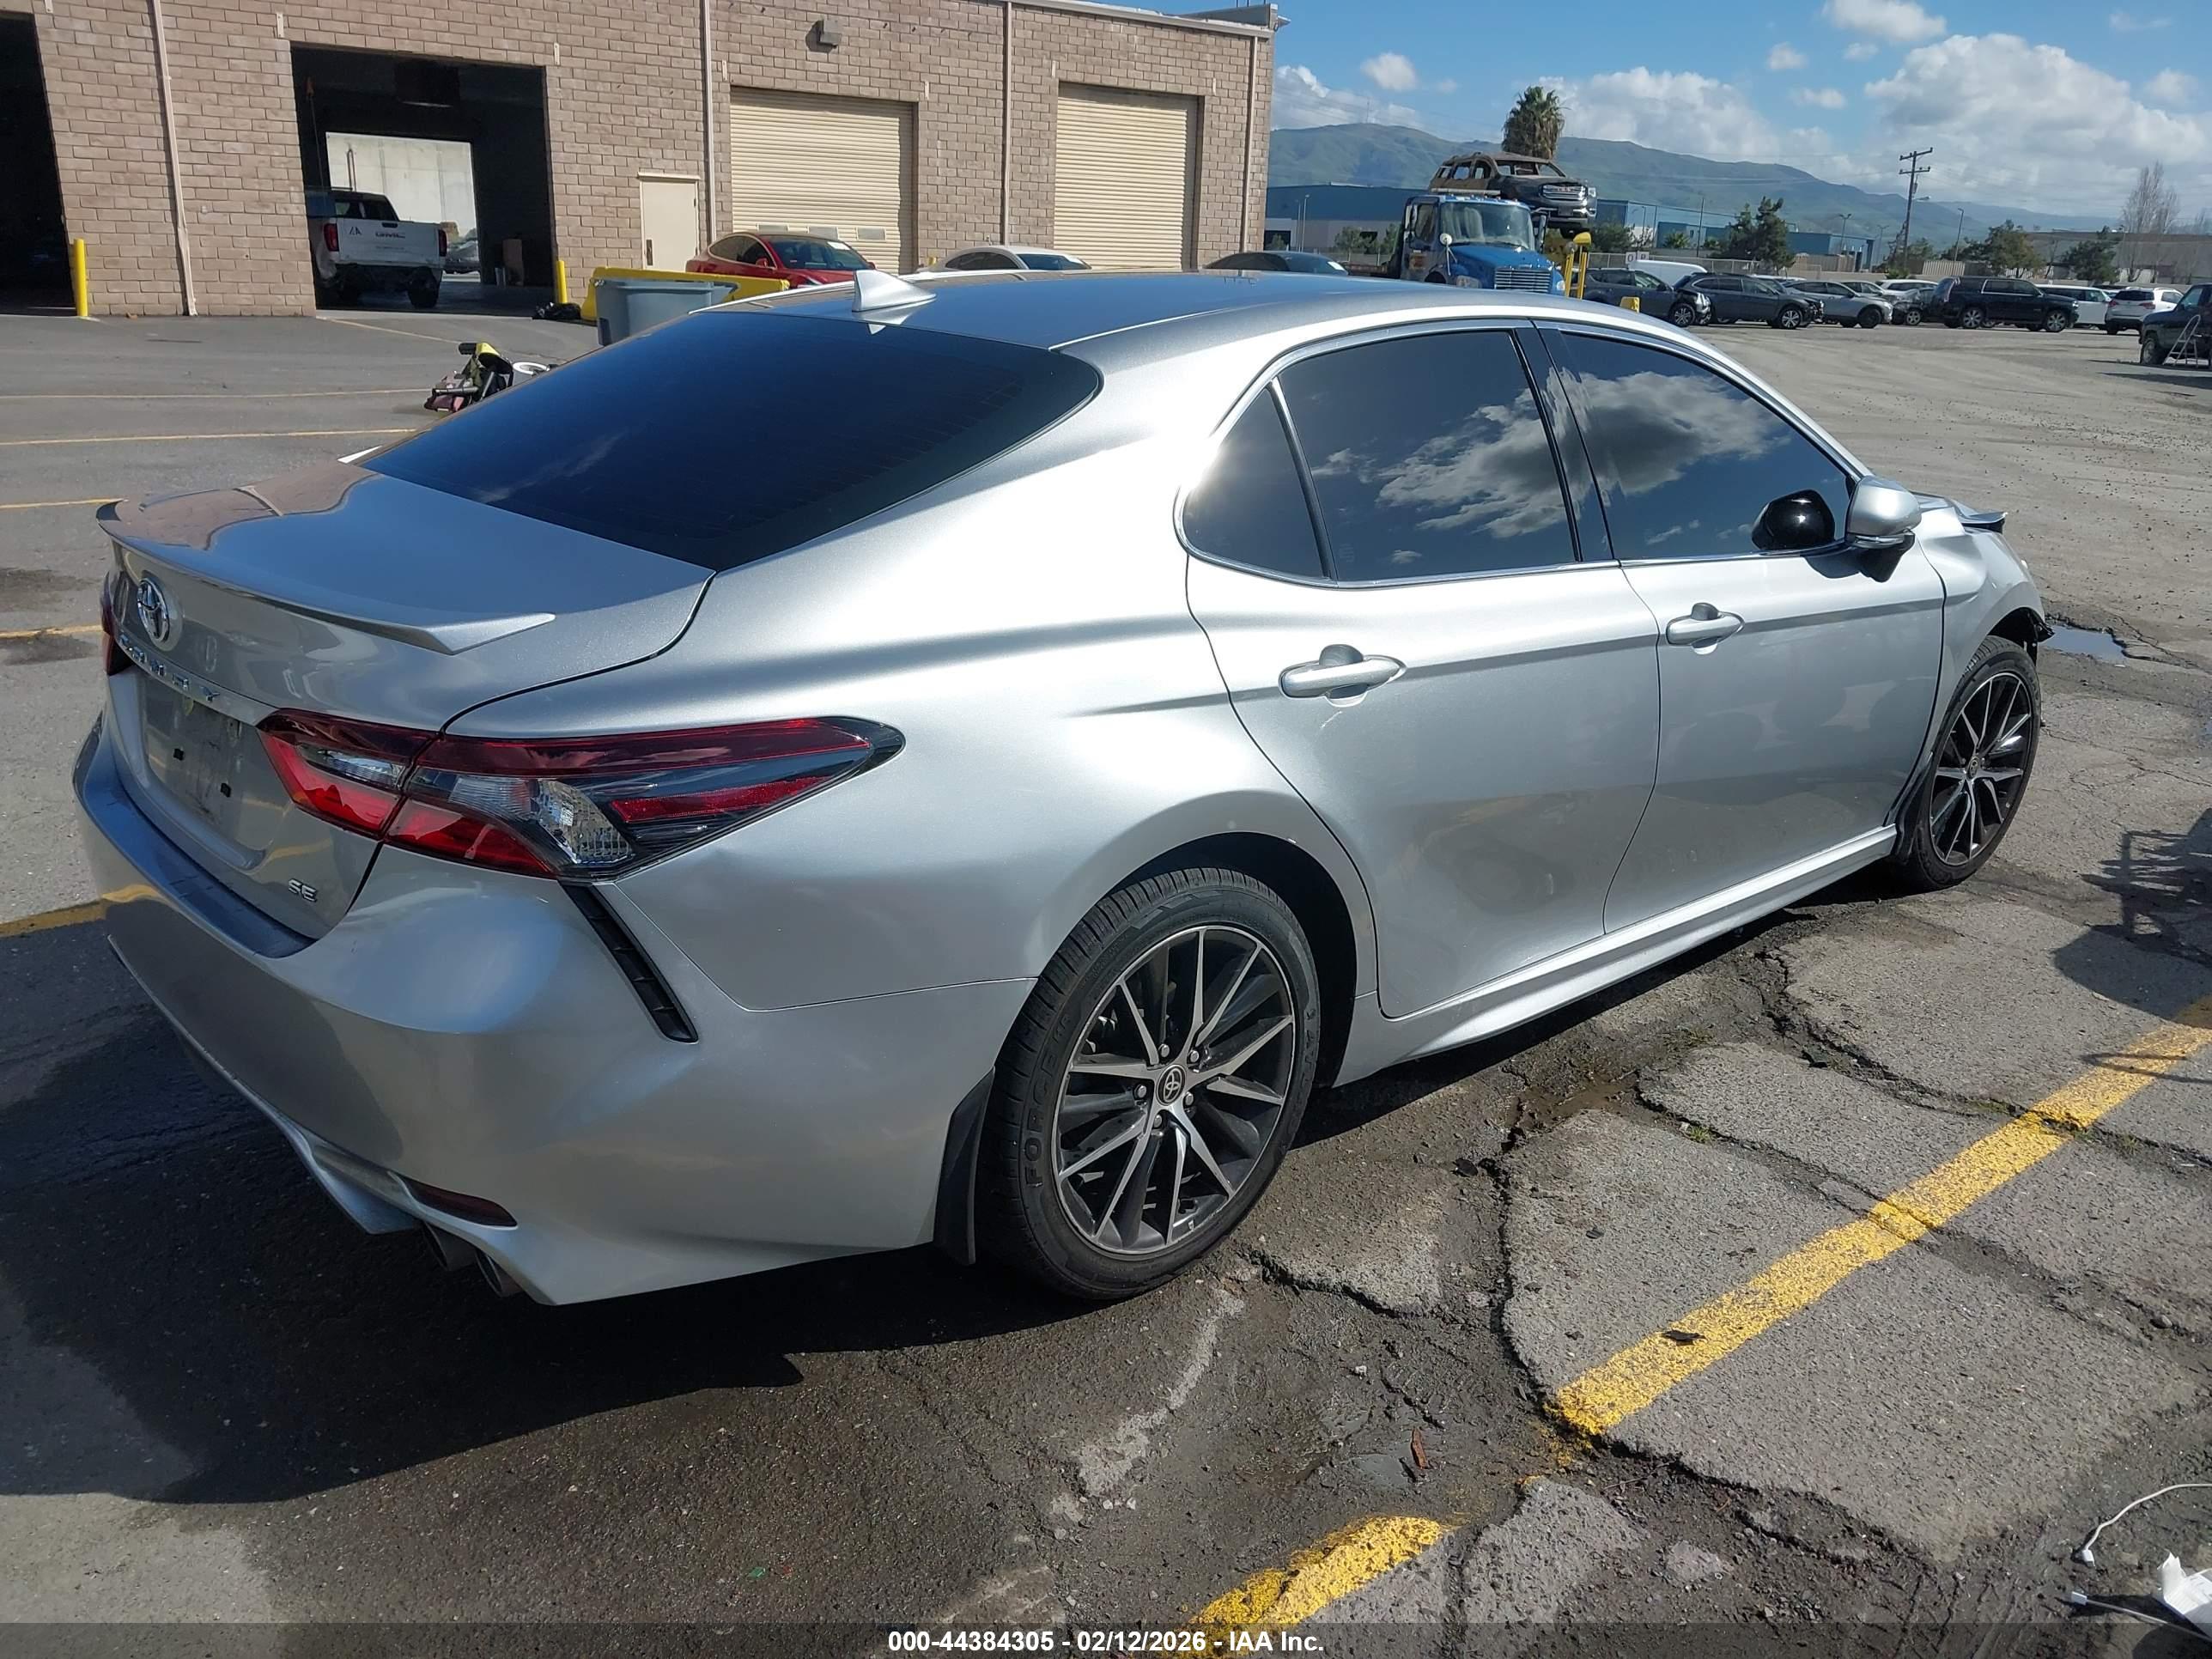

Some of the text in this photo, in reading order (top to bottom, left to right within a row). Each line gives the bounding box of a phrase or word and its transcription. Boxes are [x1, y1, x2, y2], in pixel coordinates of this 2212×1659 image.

[118, 633, 221, 703] CAMRY
[288, 878, 317, 902] SE
[1024, 1049, 1058, 1188] FORCE
